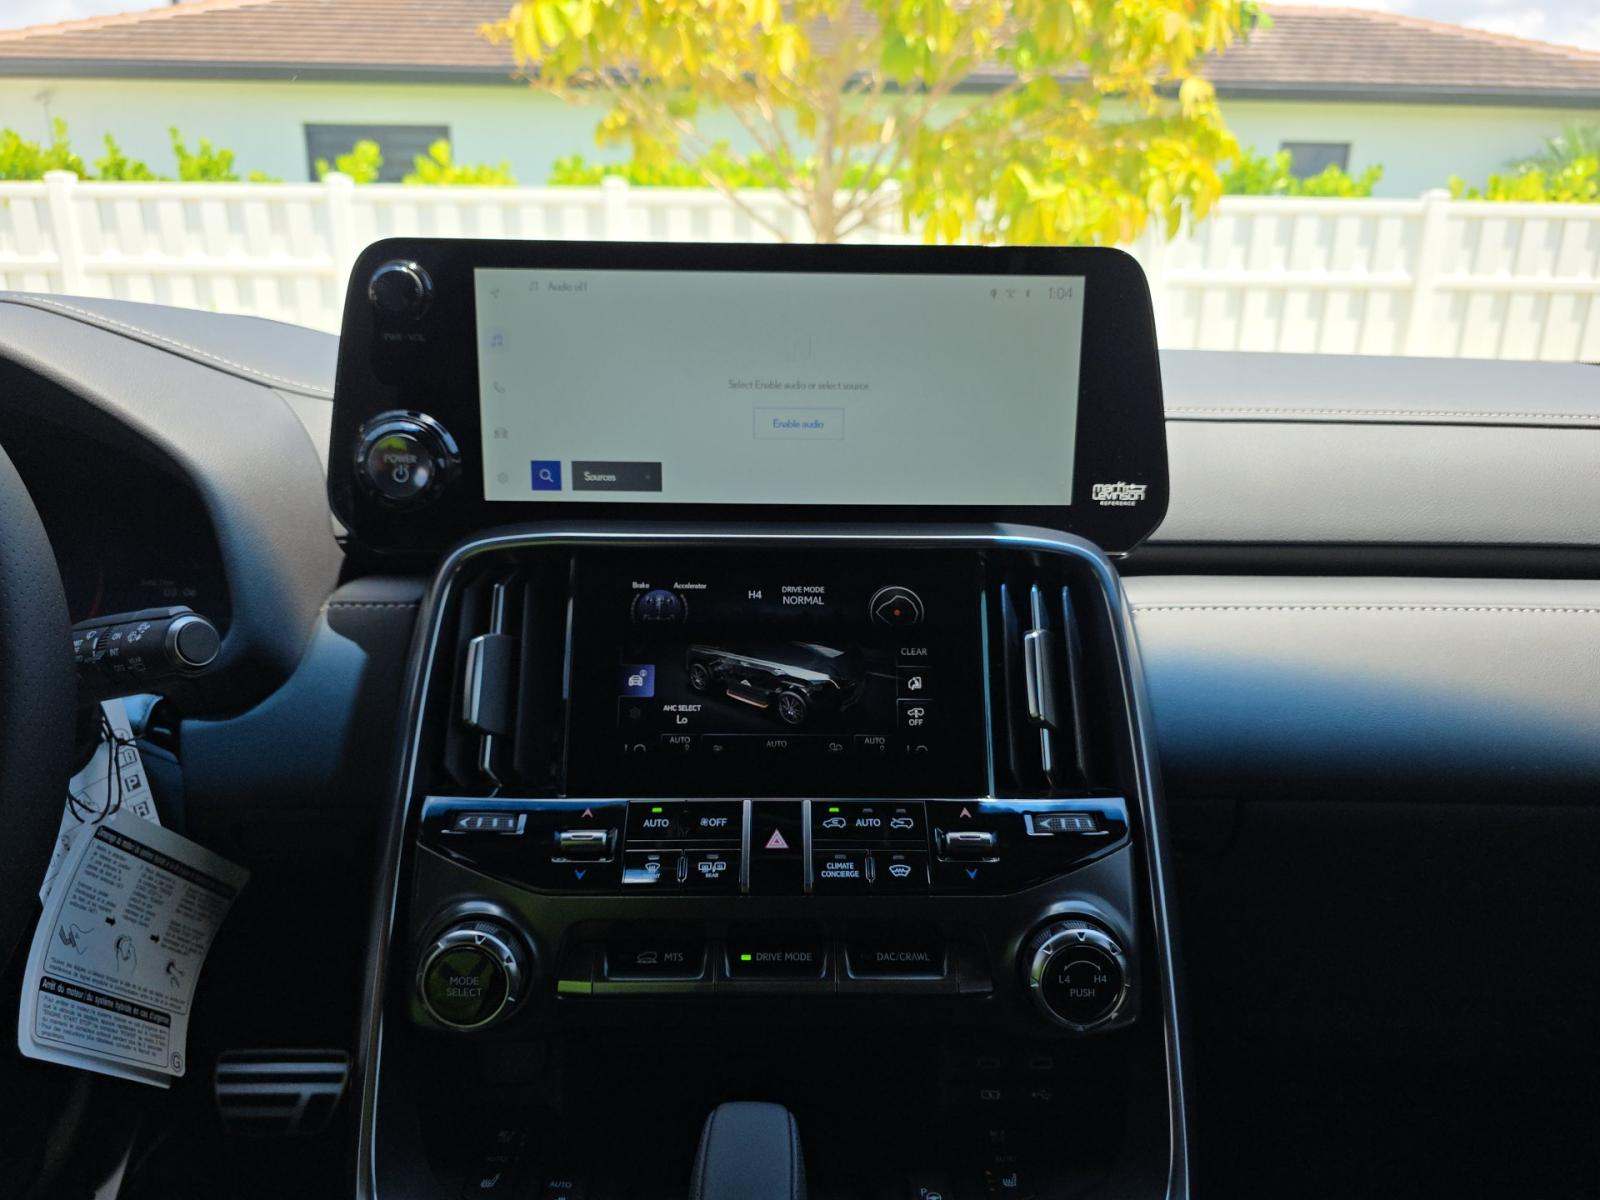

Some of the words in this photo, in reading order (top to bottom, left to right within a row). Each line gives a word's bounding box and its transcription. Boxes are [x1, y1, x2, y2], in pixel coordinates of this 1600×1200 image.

[728, 379, 752, 390] Select
[755, 379, 782, 390] Enable
[784, 380, 806, 390] audio
[773, 419, 800, 429] Enable
[801, 419, 825, 429] audio
[583, 471, 617, 482] Sources
[748, 590, 763, 600] H4
[782, 586, 802, 594] DRIVE
[803, 586, 825, 594] MODE
[782, 595, 825, 606] NORMAL
[901, 647, 928, 656] CLEAR
[663, 704, 678, 712] AHC
[678, 704, 702, 712] SELECT
[676, 714, 688, 725] Lo
[908, 718, 924, 727] OFF
[670, 736, 691, 745] AUTO
[766, 739, 788, 749] AUTO
[864, 736, 886, 745] AUTO
[643, 818, 670, 828] AUTO
[709, 817, 728, 827] OFF
[855, 818, 881, 828] AUTO
[826, 862, 855, 870] CLIMATE
[821, 870, 860, 879] CONCIERGE
[664, 952, 684, 962] MTS
[756, 952, 782, 962] DRIVE
[784, 952, 812, 962] MODE
[450, 976, 480, 986] MODE
[1058, 975, 1071, 984] L4
[1093, 975, 1107, 984] H4
[446, 987, 483, 997] SELECT
[1070, 988, 1095, 998] PUSH
